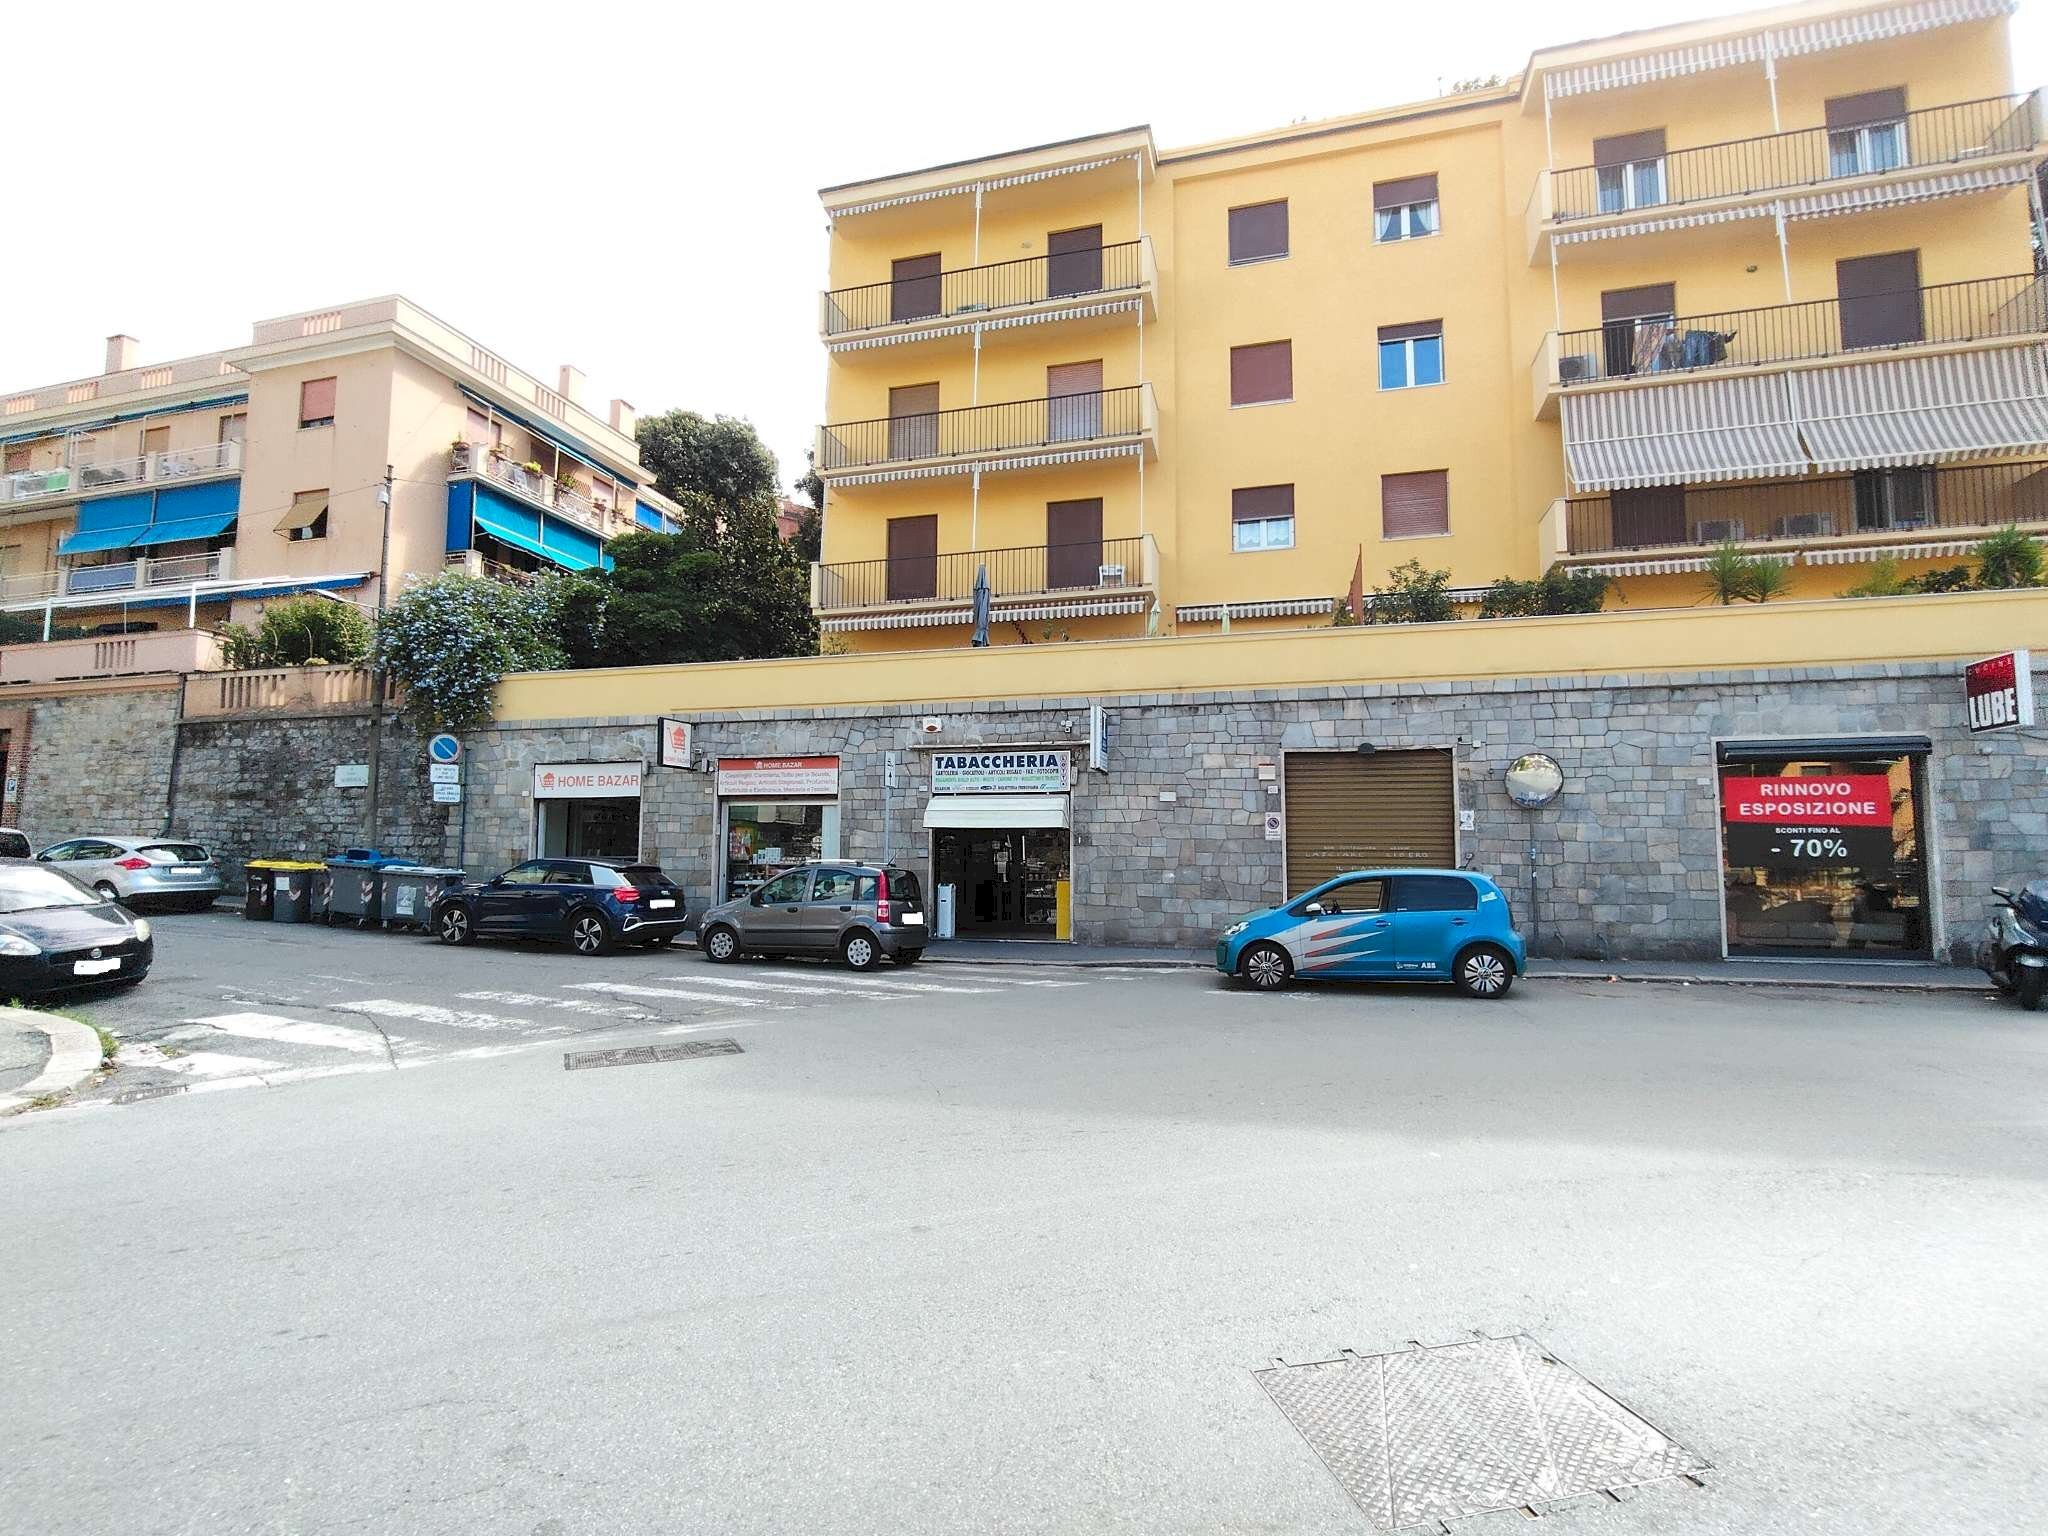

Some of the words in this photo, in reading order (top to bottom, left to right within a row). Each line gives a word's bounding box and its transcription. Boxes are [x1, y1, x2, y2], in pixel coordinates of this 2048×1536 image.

[1968, 687, 2017, 729] LUBE
[782, 761, 802, 769] BAZAR
[935, 754, 1058, 769] TABACCHERIA
[558, 775, 593, 787] HOME
[598, 774, 640, 787] BAZAR
[1761, 783, 1851, 796] RINNOVO
[1739, 802, 1876, 816] ESPOSIZIONE
[1790, 839, 1848, 857] 70%
